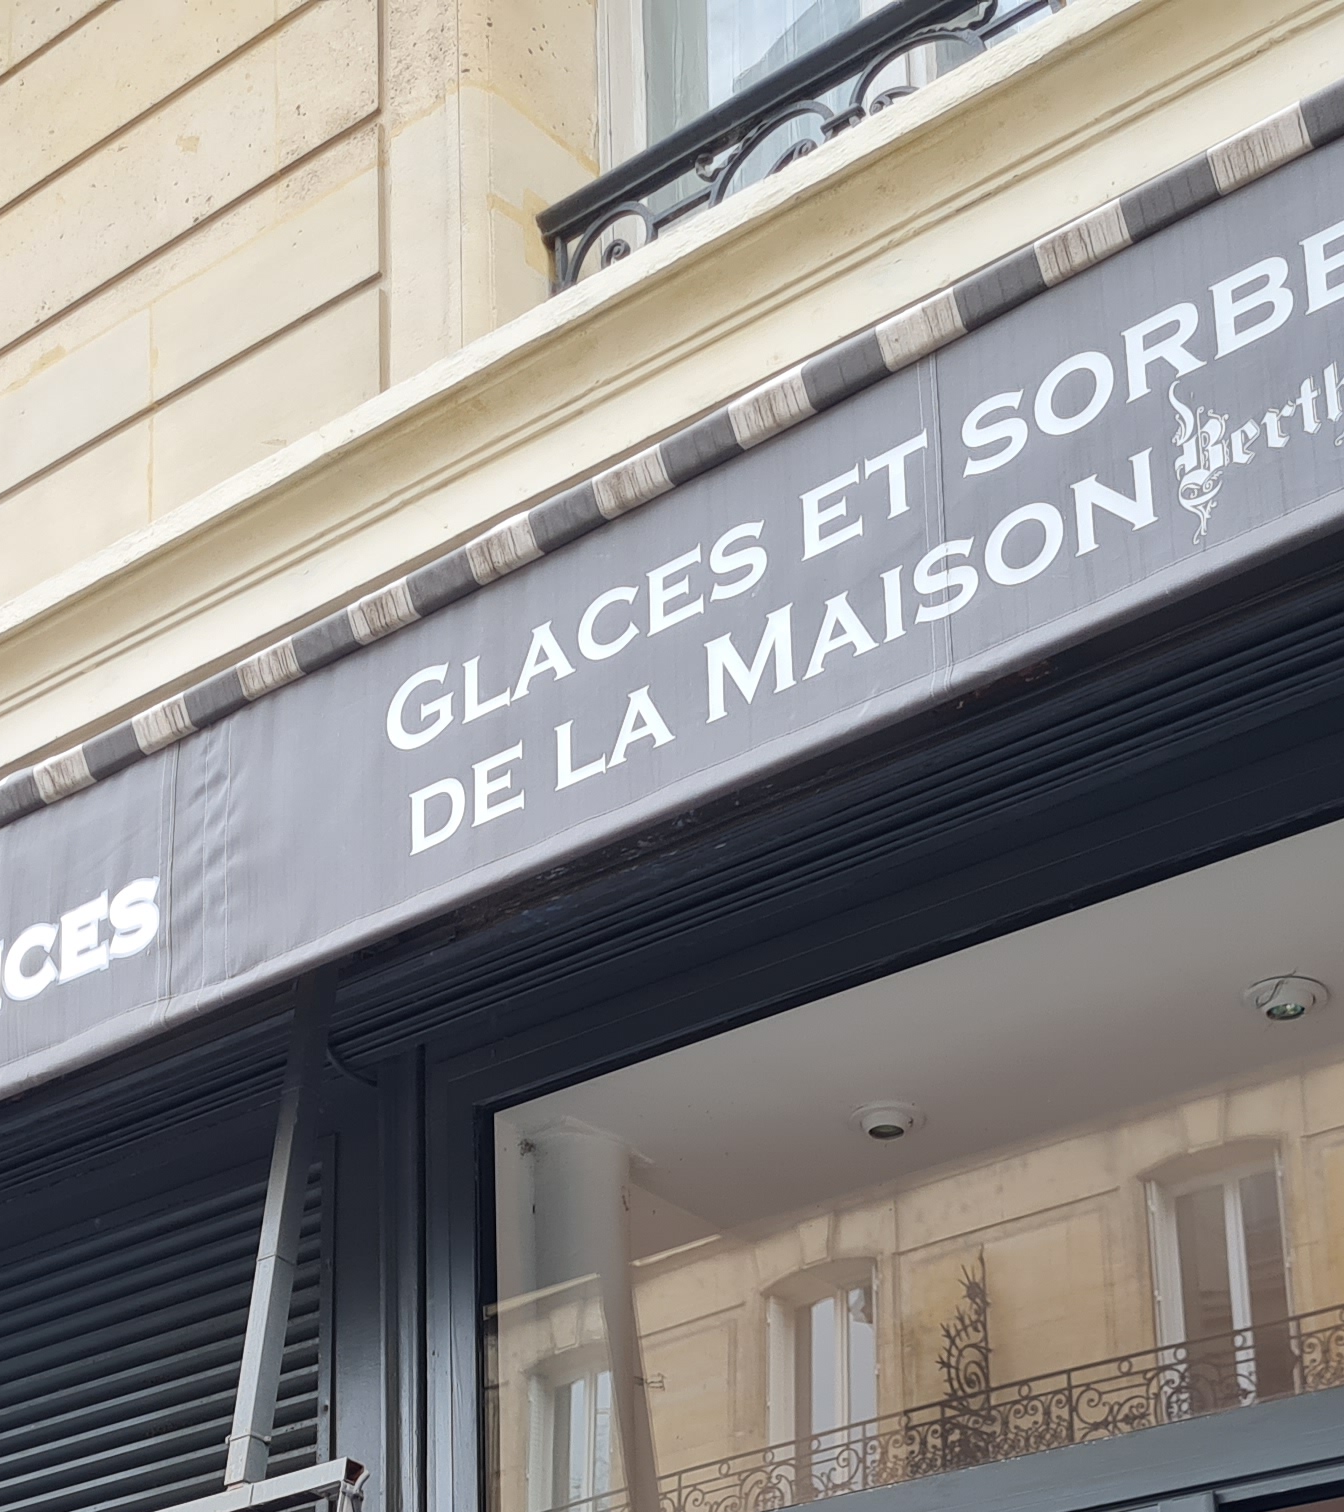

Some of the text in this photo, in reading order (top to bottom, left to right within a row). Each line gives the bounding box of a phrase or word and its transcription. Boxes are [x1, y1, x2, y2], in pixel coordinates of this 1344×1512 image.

[385, 519, 767, 751] GLACES
[800, 429, 929, 562] ET
[408, 743, 526, 857] DE
[554, 690, 675, 794] LA
[705, 447, 1158, 725] MAISON
